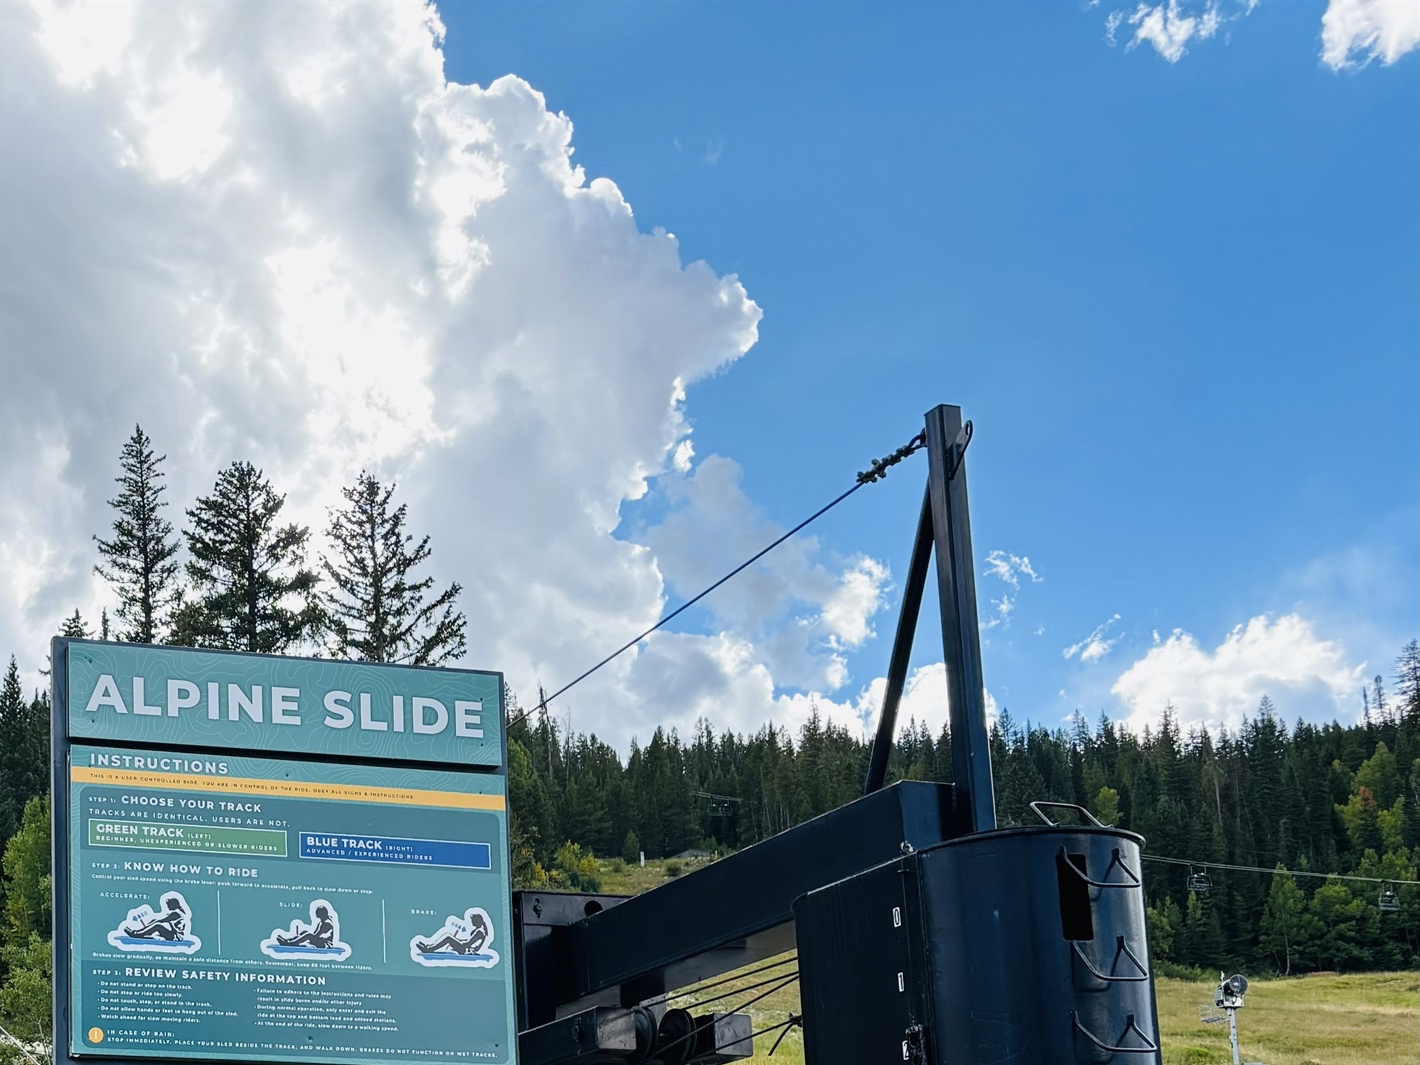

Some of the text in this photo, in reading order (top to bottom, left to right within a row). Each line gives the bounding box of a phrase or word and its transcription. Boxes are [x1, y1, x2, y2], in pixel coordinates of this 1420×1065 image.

[85, 674, 484, 738] ALPINE SLIDE
[90, 753, 227, 774] INSTRUCTIONS
[121, 795, 174, 806] CHOOSE
[179, 798, 214, 809] YOUR
[218, 801, 261, 812] TRACK
[88, 808, 125, 816] TRACKS
[152, 812, 207, 821] IDENTICAL.
[212, 816, 241, 824] USERS
[268, 819, 289, 827] NOT.
[96, 823, 138, 834] GREEN
[141, 826, 183, 837] TRACK
[306, 836, 338, 847] BLUE
[341, 838, 382, 850] TRACK
[354, 850, 403, 858] EXPERIENCED
[124, 861, 164, 872] KNOW
[170, 864, 201, 874] HOW
[206, 866, 223, 875] TO
[228, 867, 258, 877] RIDE
[125, 967, 176, 978] REVIEW
[181, 970, 230, 980] SAFETY
[235, 972, 325, 985] INFORMATION
